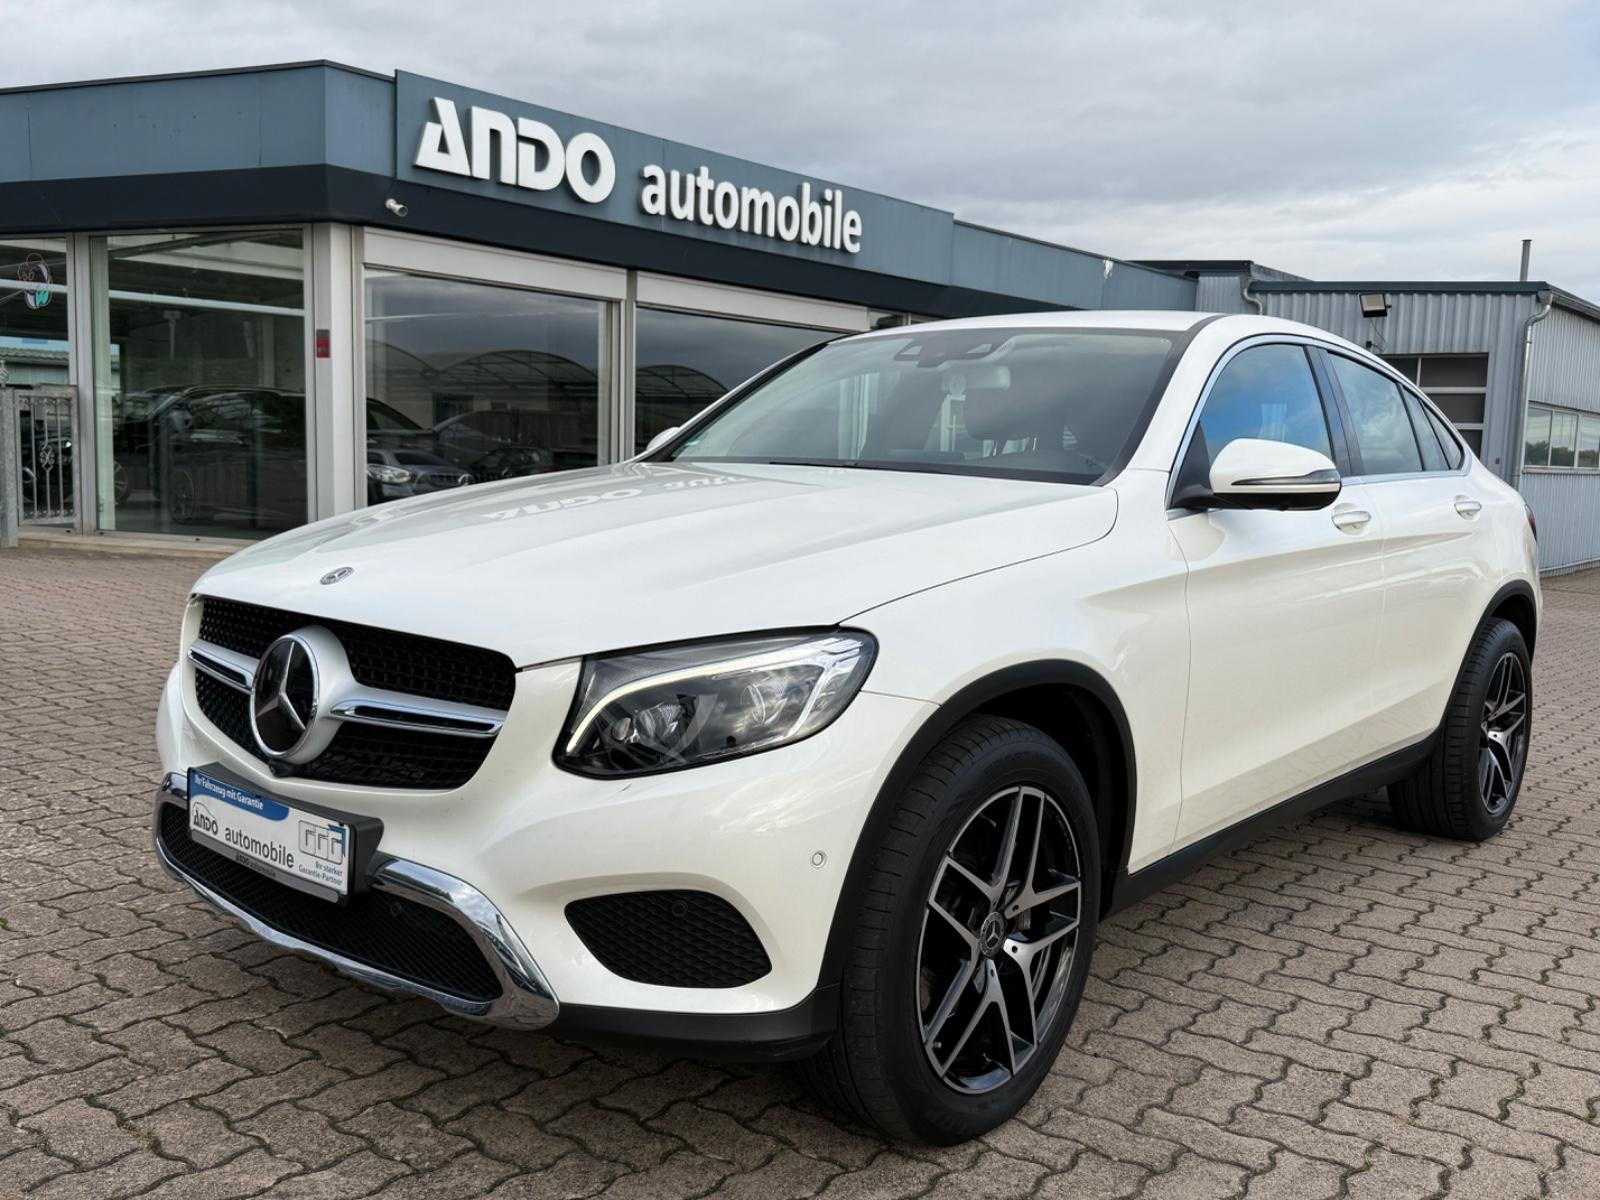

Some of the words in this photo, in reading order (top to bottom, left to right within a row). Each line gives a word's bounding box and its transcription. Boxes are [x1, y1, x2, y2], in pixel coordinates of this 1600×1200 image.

[415, 97, 616, 204] ANDO
[641, 164, 863, 253] automobile
[202, 777, 226, 798] Fahrzeug
[226, 789, 237, 800] mit
[236, 792, 264, 810] Garantie
[193, 808, 218, 836] ANDO
[225, 827, 294, 868] automobile
